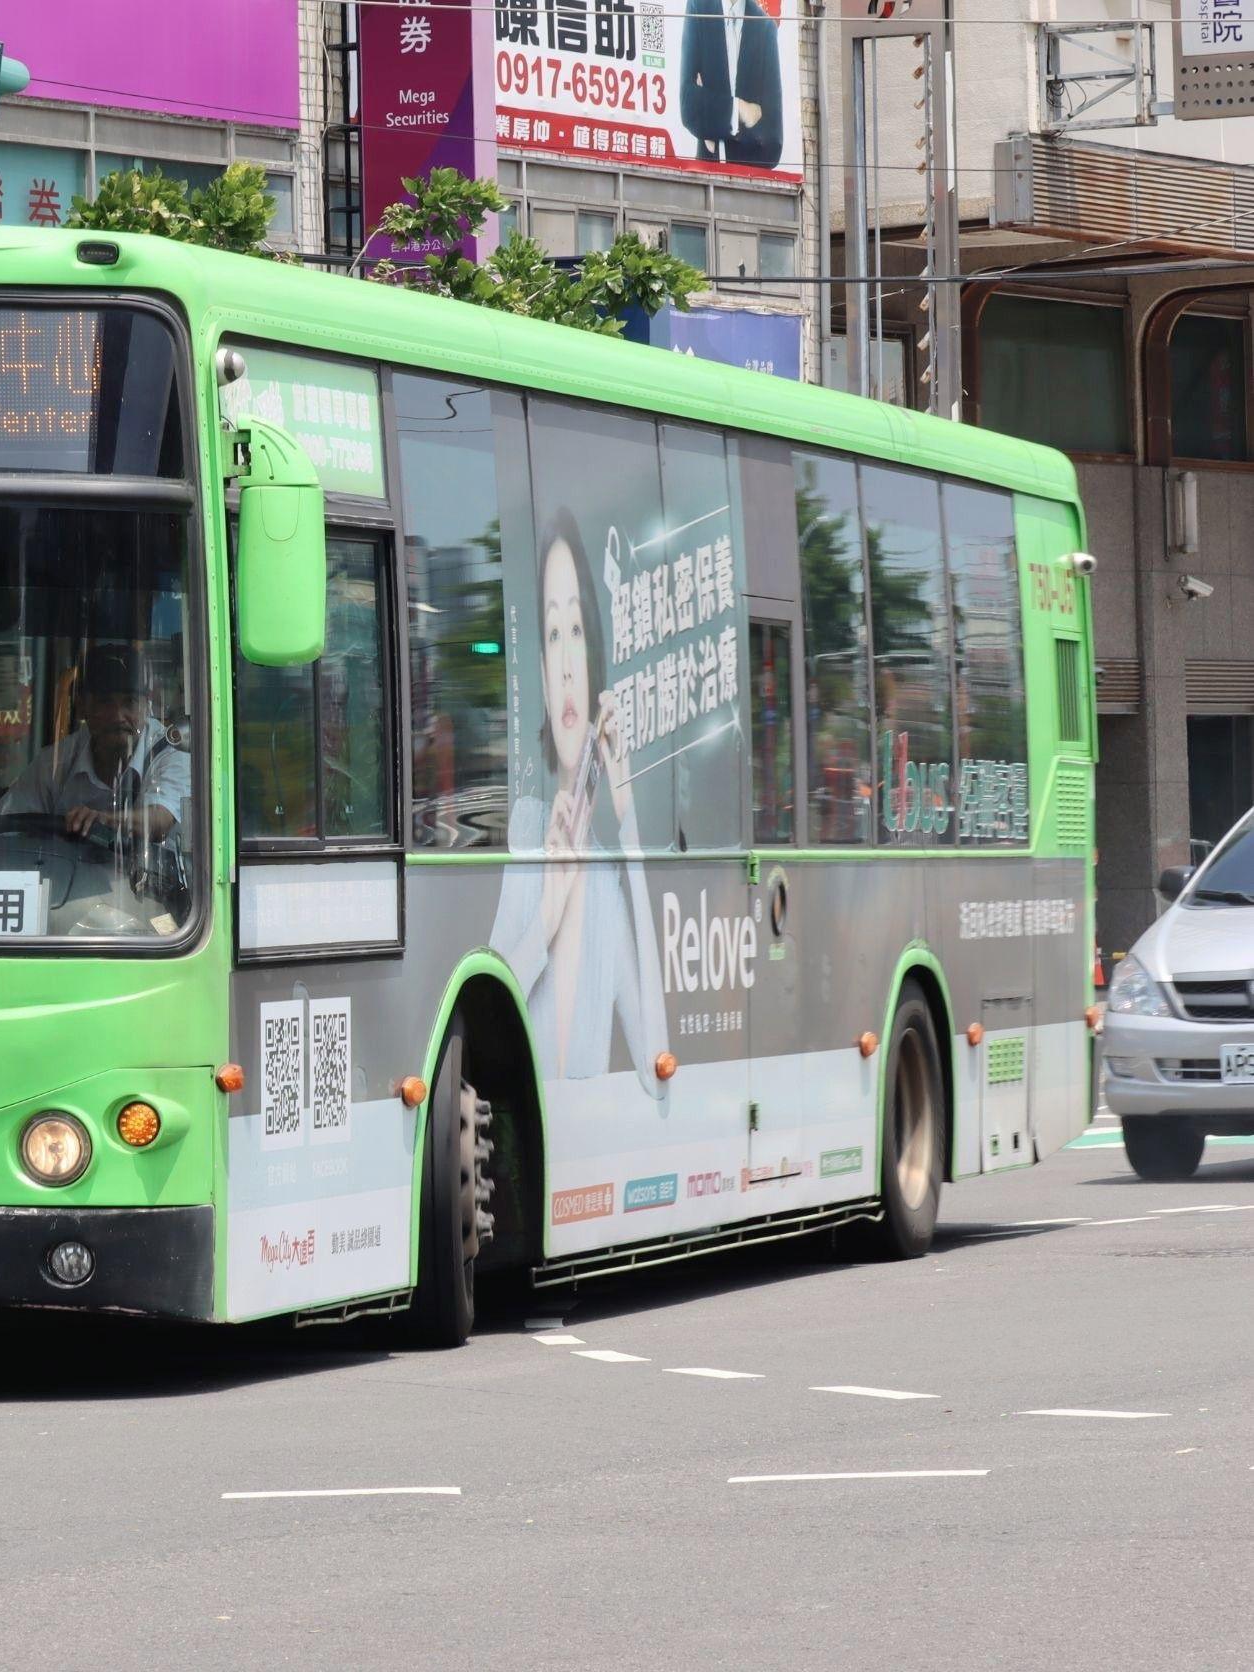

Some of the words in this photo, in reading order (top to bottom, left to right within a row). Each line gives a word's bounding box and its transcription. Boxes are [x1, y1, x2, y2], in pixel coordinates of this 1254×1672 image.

[399, 0, 432, 54] 券
[1213, 0, 1243, 43] 院
[399, 89, 436, 105] Mega
[497, 50, 667, 115] 0917-659213
[385, 110, 450, 128] Securities
[662, 888, 758, 993] Relove
